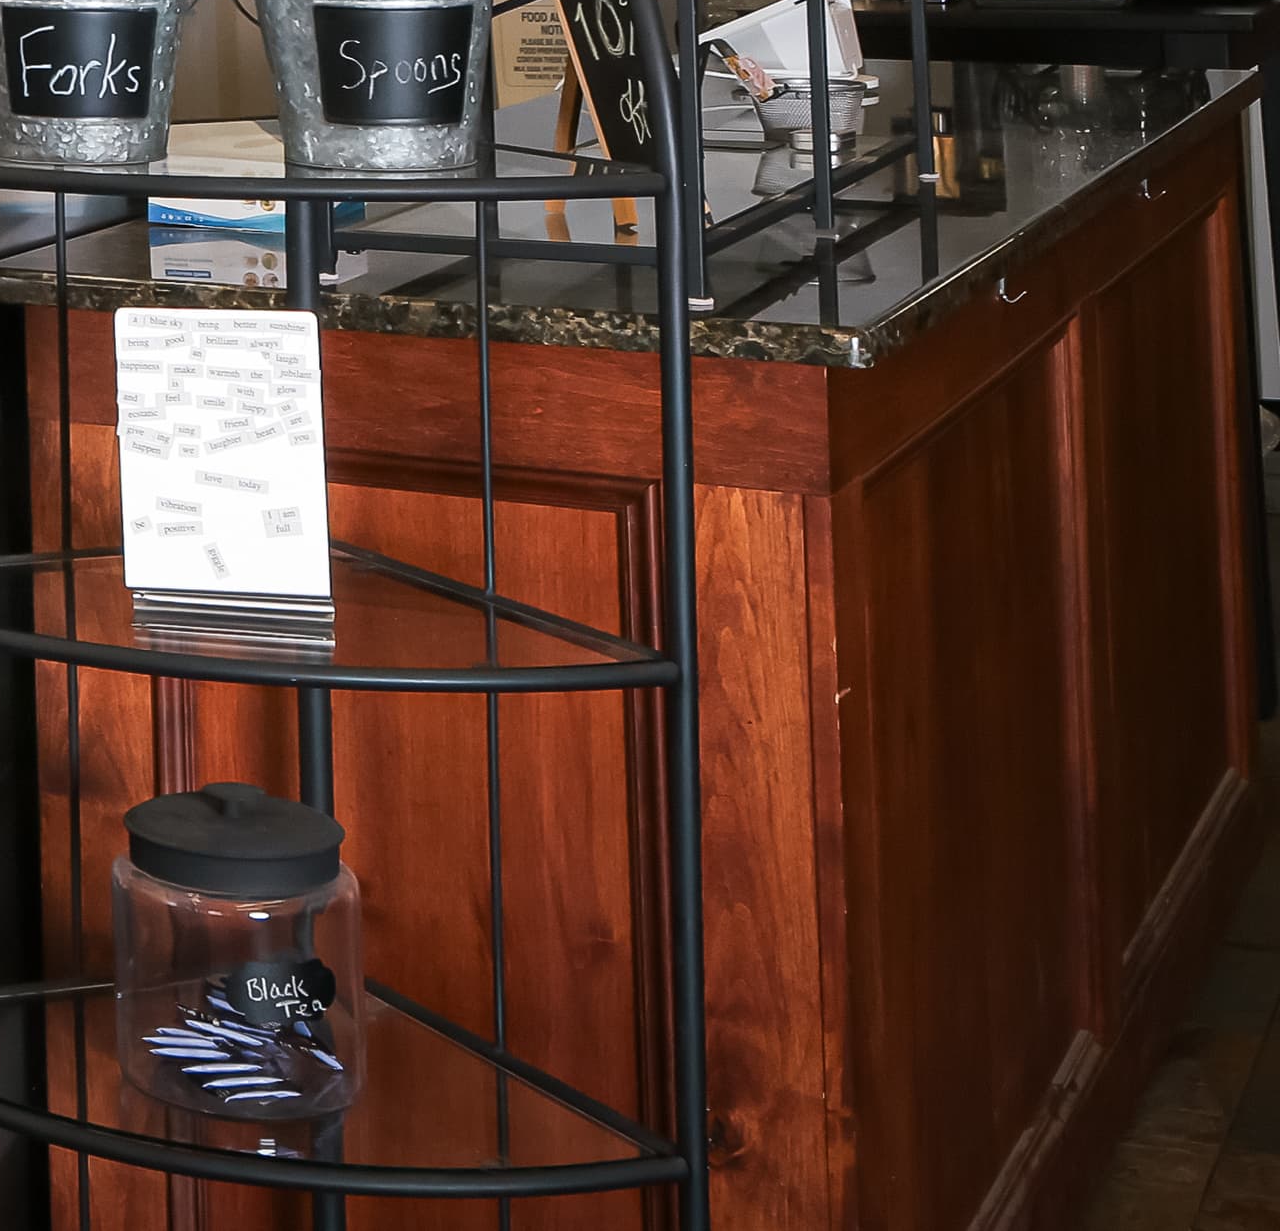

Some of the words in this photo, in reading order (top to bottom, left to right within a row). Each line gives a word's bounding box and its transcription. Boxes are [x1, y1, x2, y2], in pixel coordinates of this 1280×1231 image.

[521, 12, 547, 22] FOOD
[20, 26, 141, 98] Forks
[340, 40, 461, 100] Spoons
[204, 473, 223, 484] love
[238, 479, 261, 491] today
[246, 975, 310, 1001] Black
[276, 998, 327, 1019] Tea
